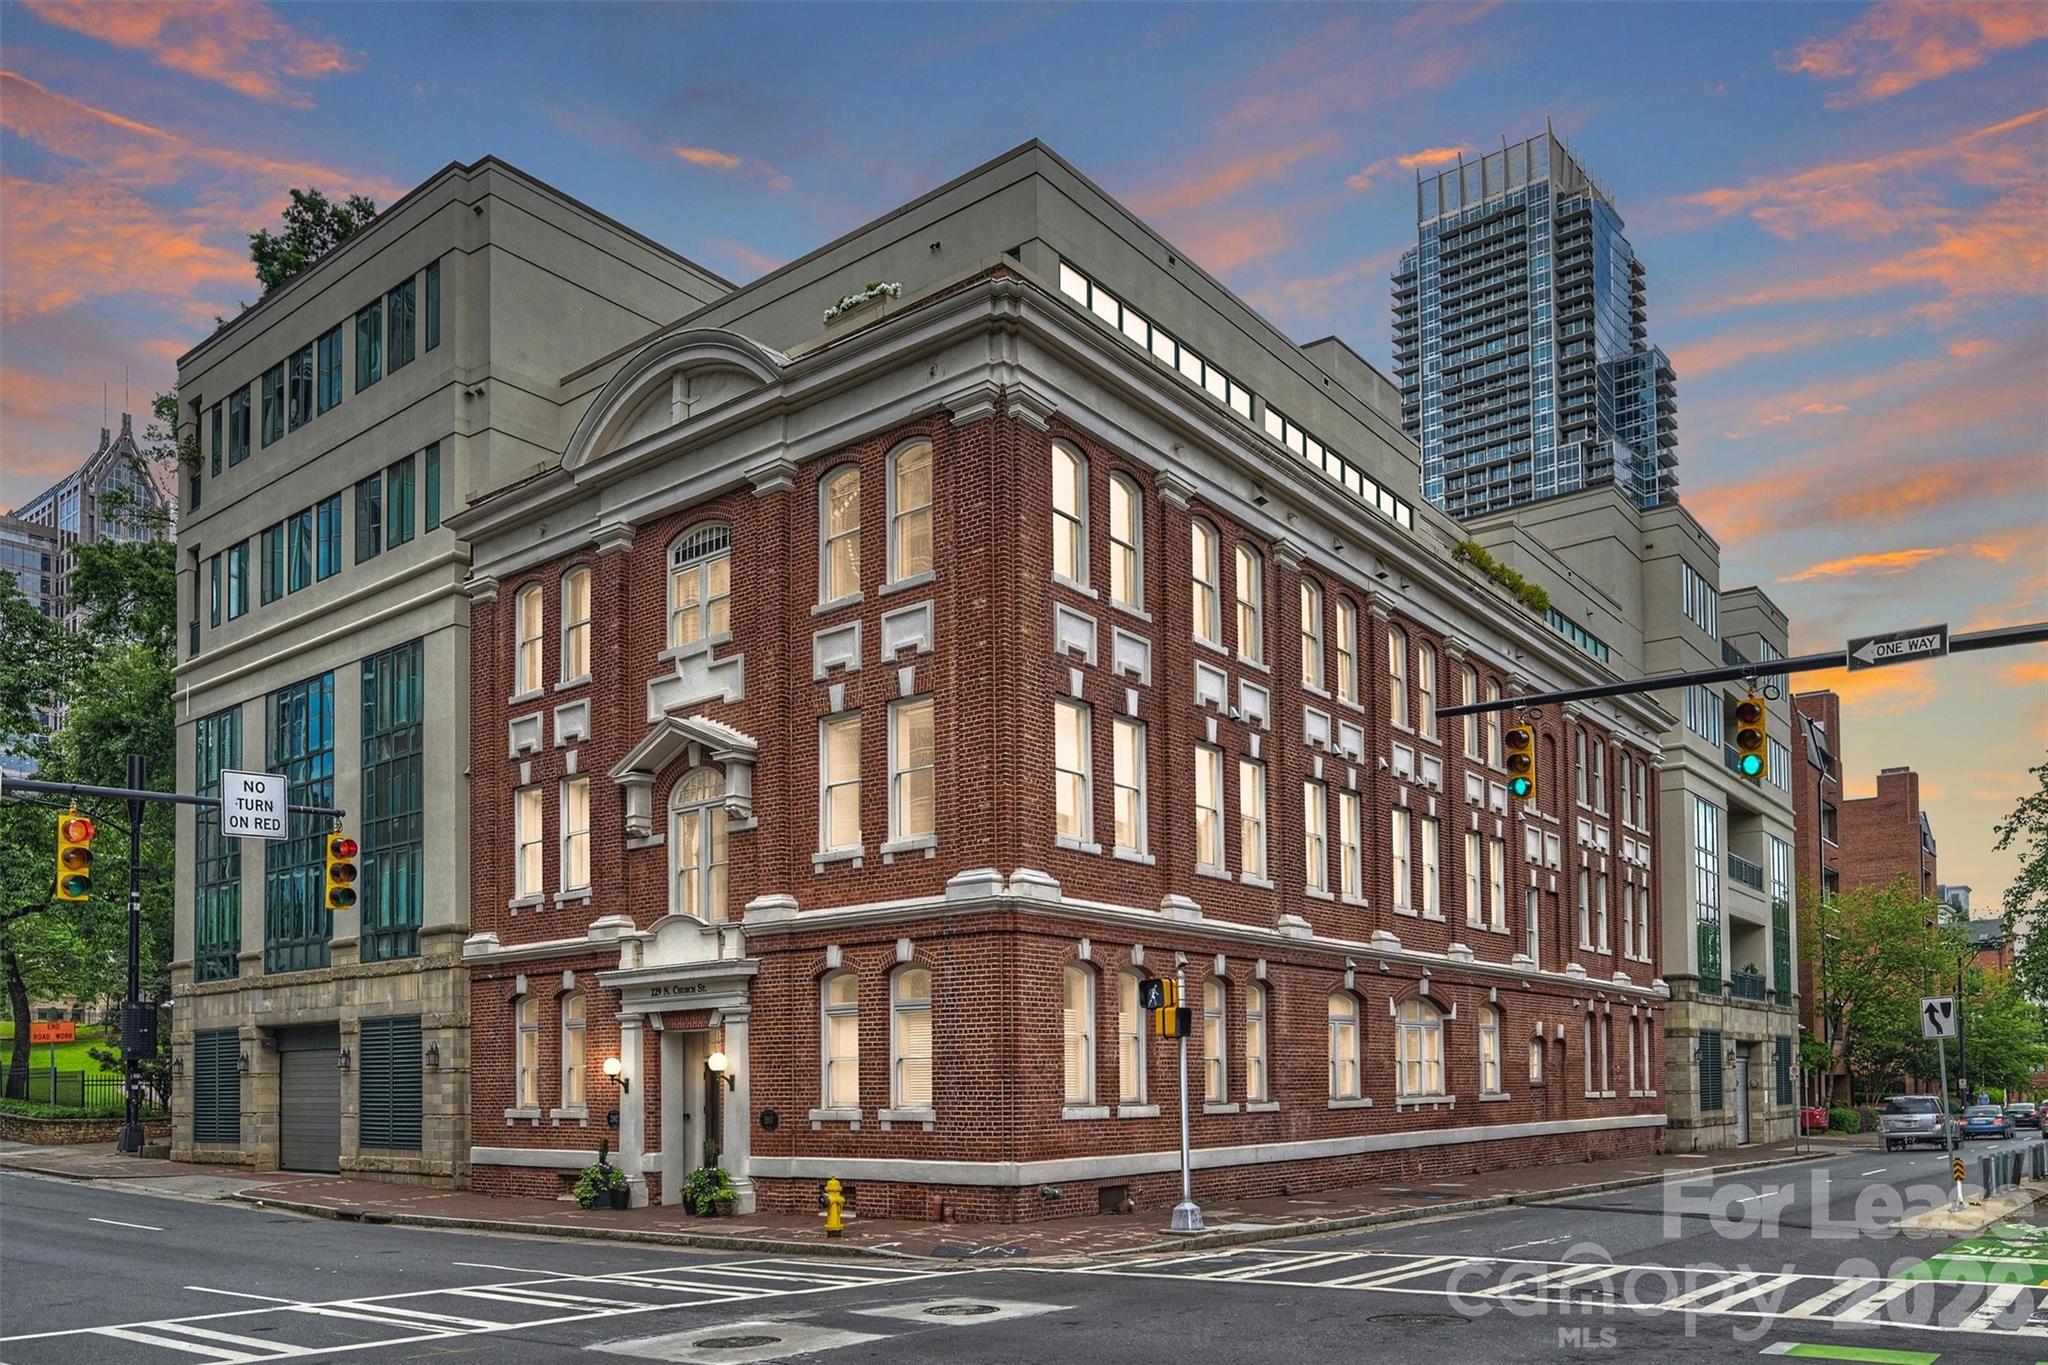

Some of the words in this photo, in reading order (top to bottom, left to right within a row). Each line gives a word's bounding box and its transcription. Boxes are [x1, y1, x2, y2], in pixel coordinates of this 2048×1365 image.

[1876, 642, 1903, 656] ONE
[1908, 636, 1936, 651] WAY
[243, 780, 266, 794] NO
[236, 797, 274, 812] TURN
[229, 815, 249, 829] ON
[254, 817, 281, 831] RED
[32, 1033, 51, 1041] ROAD
